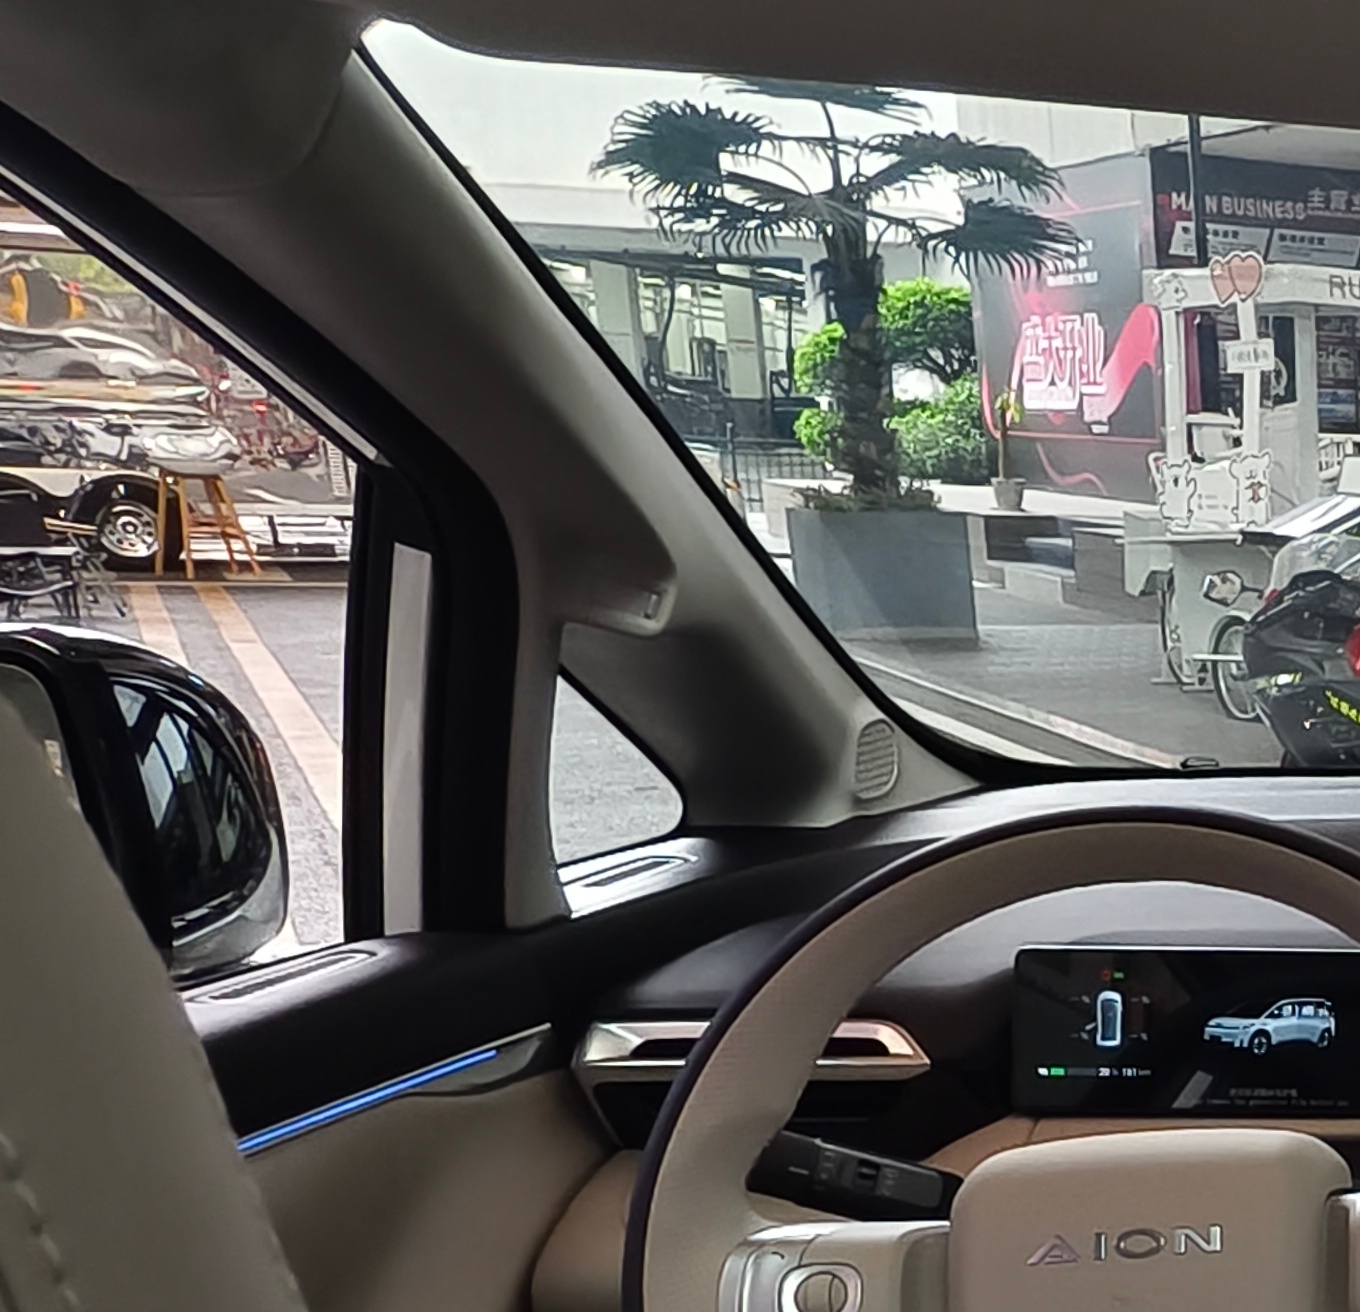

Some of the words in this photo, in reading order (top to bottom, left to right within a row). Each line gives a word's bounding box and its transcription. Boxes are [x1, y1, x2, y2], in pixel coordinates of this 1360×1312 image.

[1171, 191, 1218, 215] MN
[1221, 195, 1306, 220] BUSINESS
[1026, 1224, 1223, 1266] AION
